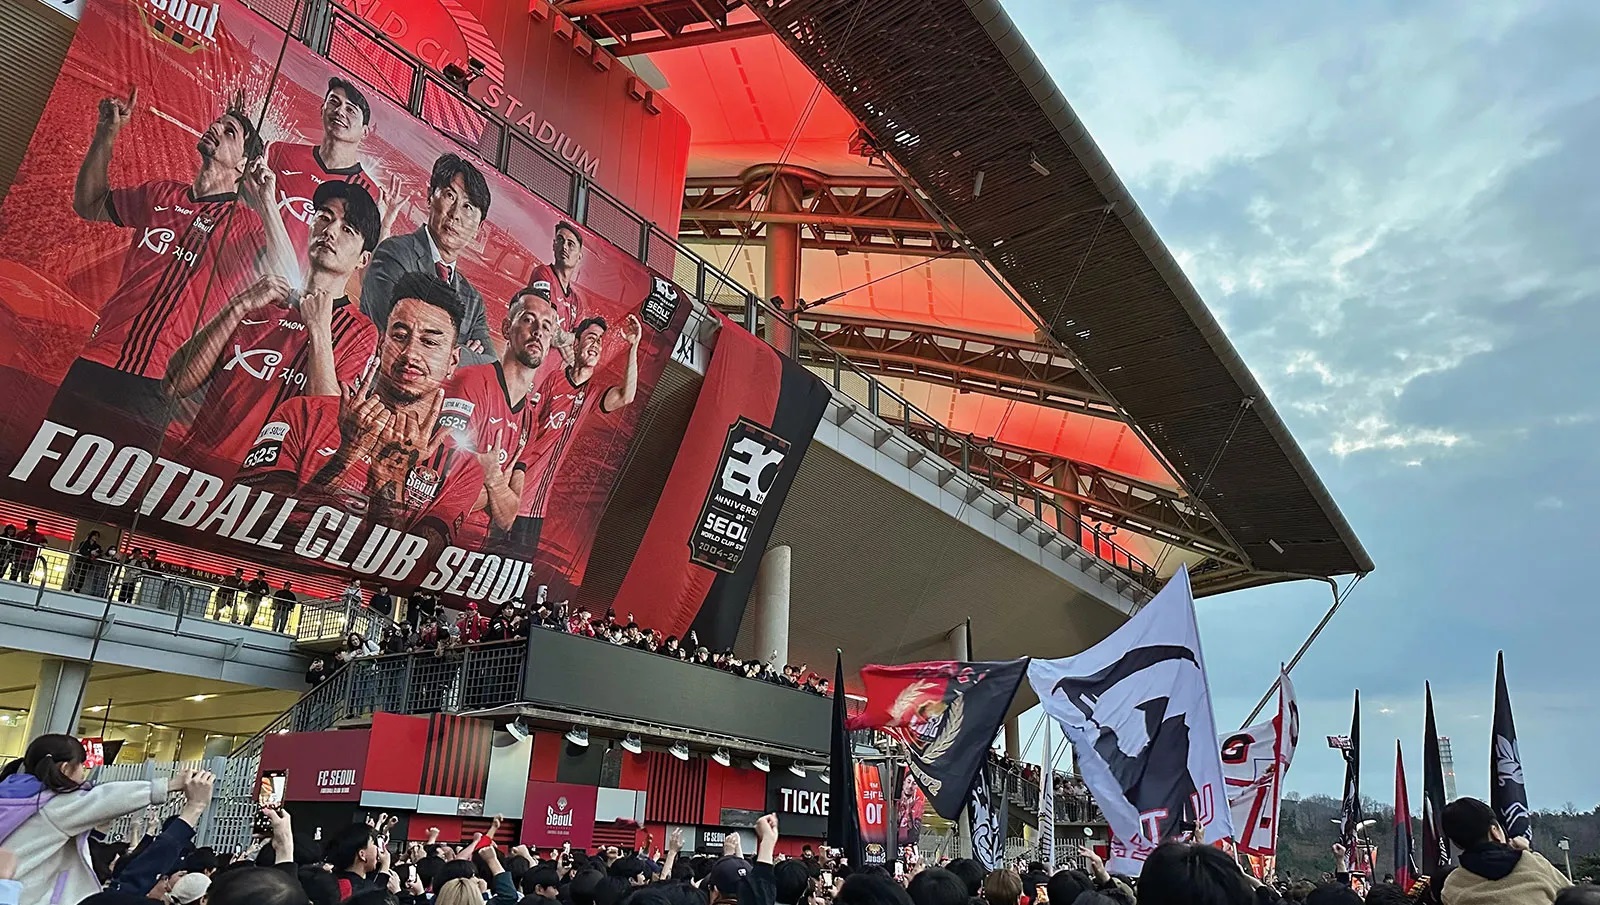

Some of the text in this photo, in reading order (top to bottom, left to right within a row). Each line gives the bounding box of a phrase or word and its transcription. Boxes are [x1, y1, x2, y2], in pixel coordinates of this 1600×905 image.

[482, 84, 600, 178] STADIUM
[172, 246, 198, 267] 자이
[278, 319, 305, 331] TMON
[279, 367, 308, 390] 자이
[439, 416, 467, 431] GS25
[242, 446, 279, 469] GS25
[407, 470, 437, 498] Seoul
[9, 419, 299, 550] FOOTBALL
[294, 505, 429, 581] CLUB
[714, 493, 759, 516] ANNIVERS
[735, 513, 746, 522] at
[698, 542, 740, 562] 2004-20
[720, 538, 736, 547] CUP
[317, 769, 356, 786] FC SEOUL
[780, 787, 830, 816] TICKE
[546, 805, 573, 827] Seoul
[703, 831, 711, 842] FC
